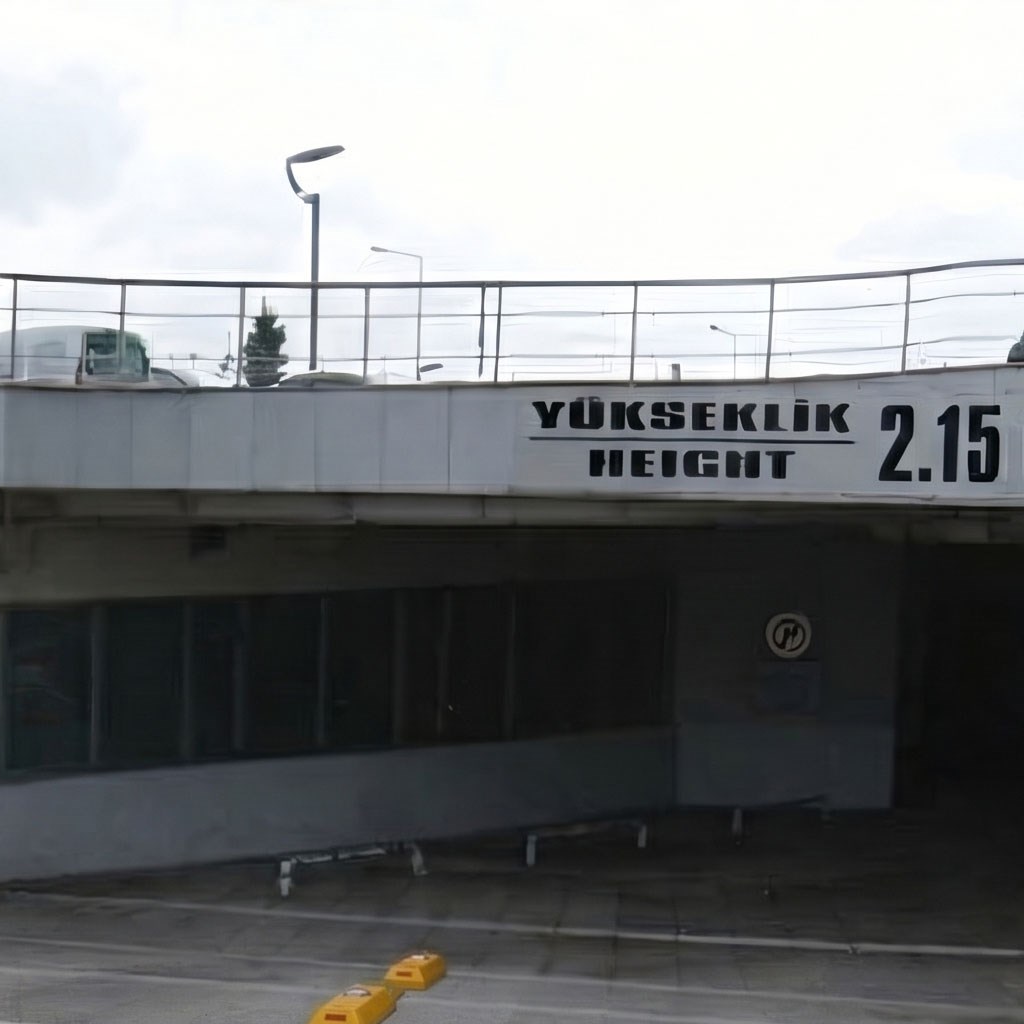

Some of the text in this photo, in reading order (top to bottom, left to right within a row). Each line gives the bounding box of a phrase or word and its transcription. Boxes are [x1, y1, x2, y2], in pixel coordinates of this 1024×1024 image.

[532, 396, 850, 433] YÜKSEKLİK
[878, 404, 1001, 483] 2.15
[589, 449, 796, 479] HEIGHT
